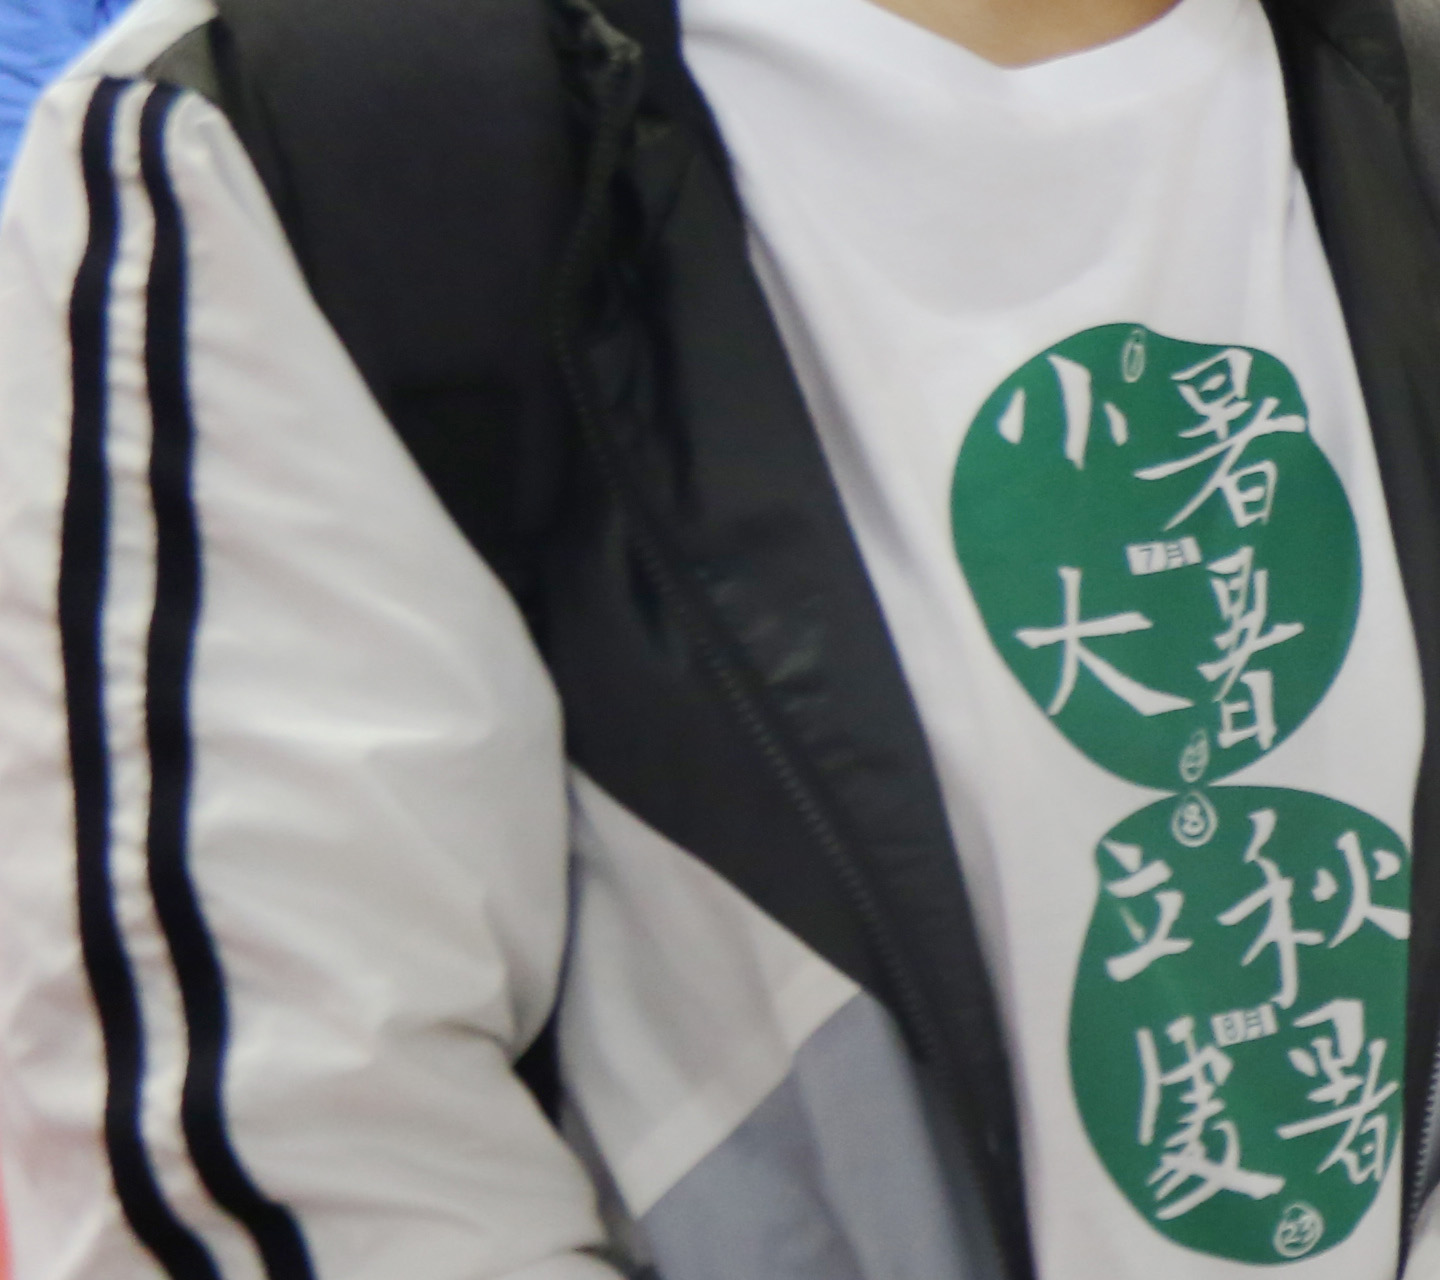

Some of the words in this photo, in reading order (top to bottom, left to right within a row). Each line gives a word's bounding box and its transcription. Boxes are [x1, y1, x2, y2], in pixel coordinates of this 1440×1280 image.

[998, 347, 1306, 531] 小暑
[1015, 546, 1304, 751] 大暑
[1103, 808, 1411, 1008] 立秋
